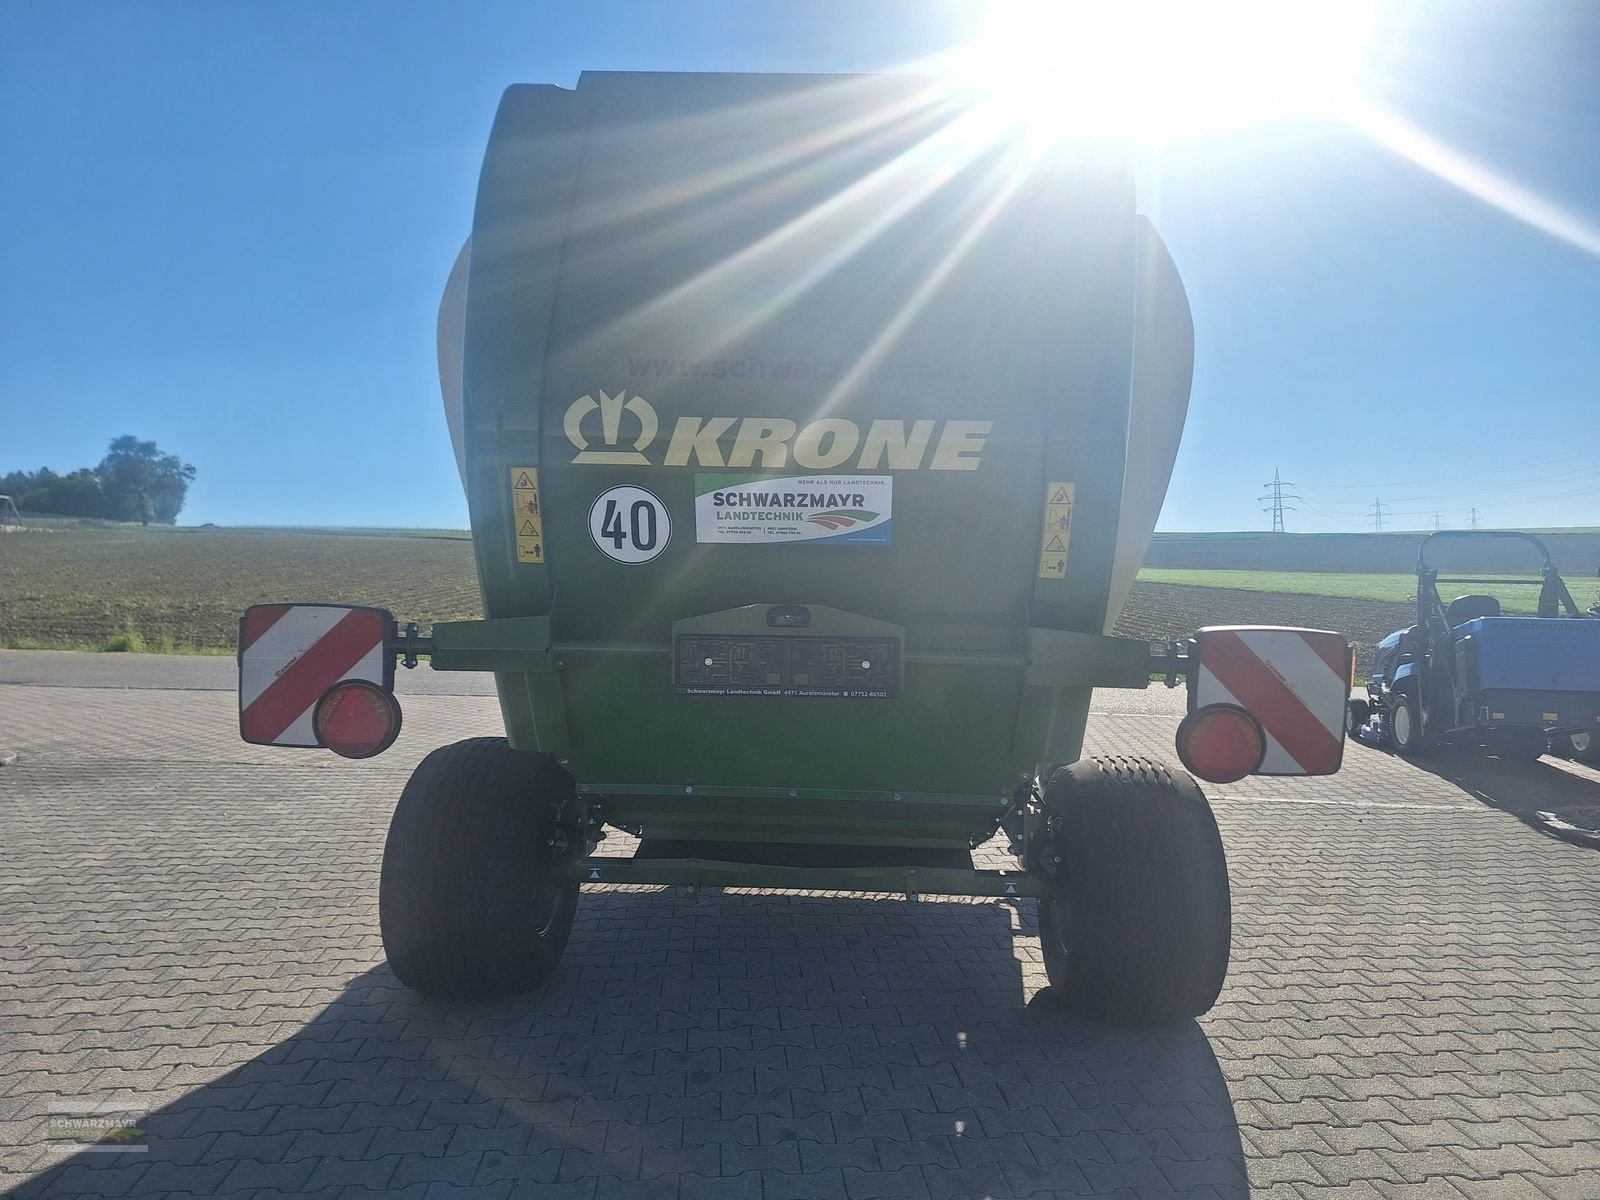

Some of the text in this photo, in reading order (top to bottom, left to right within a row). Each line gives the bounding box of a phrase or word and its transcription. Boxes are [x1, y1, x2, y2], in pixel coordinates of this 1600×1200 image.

[664, 416, 994, 471] KRONE
[713, 492, 865, 508] SCHWARZMAYR
[716, 510, 804, 521] LANDTECHNIK
[600, 499, 657, 551] 40
[686, 688, 725, 696] Schwarzmayr
